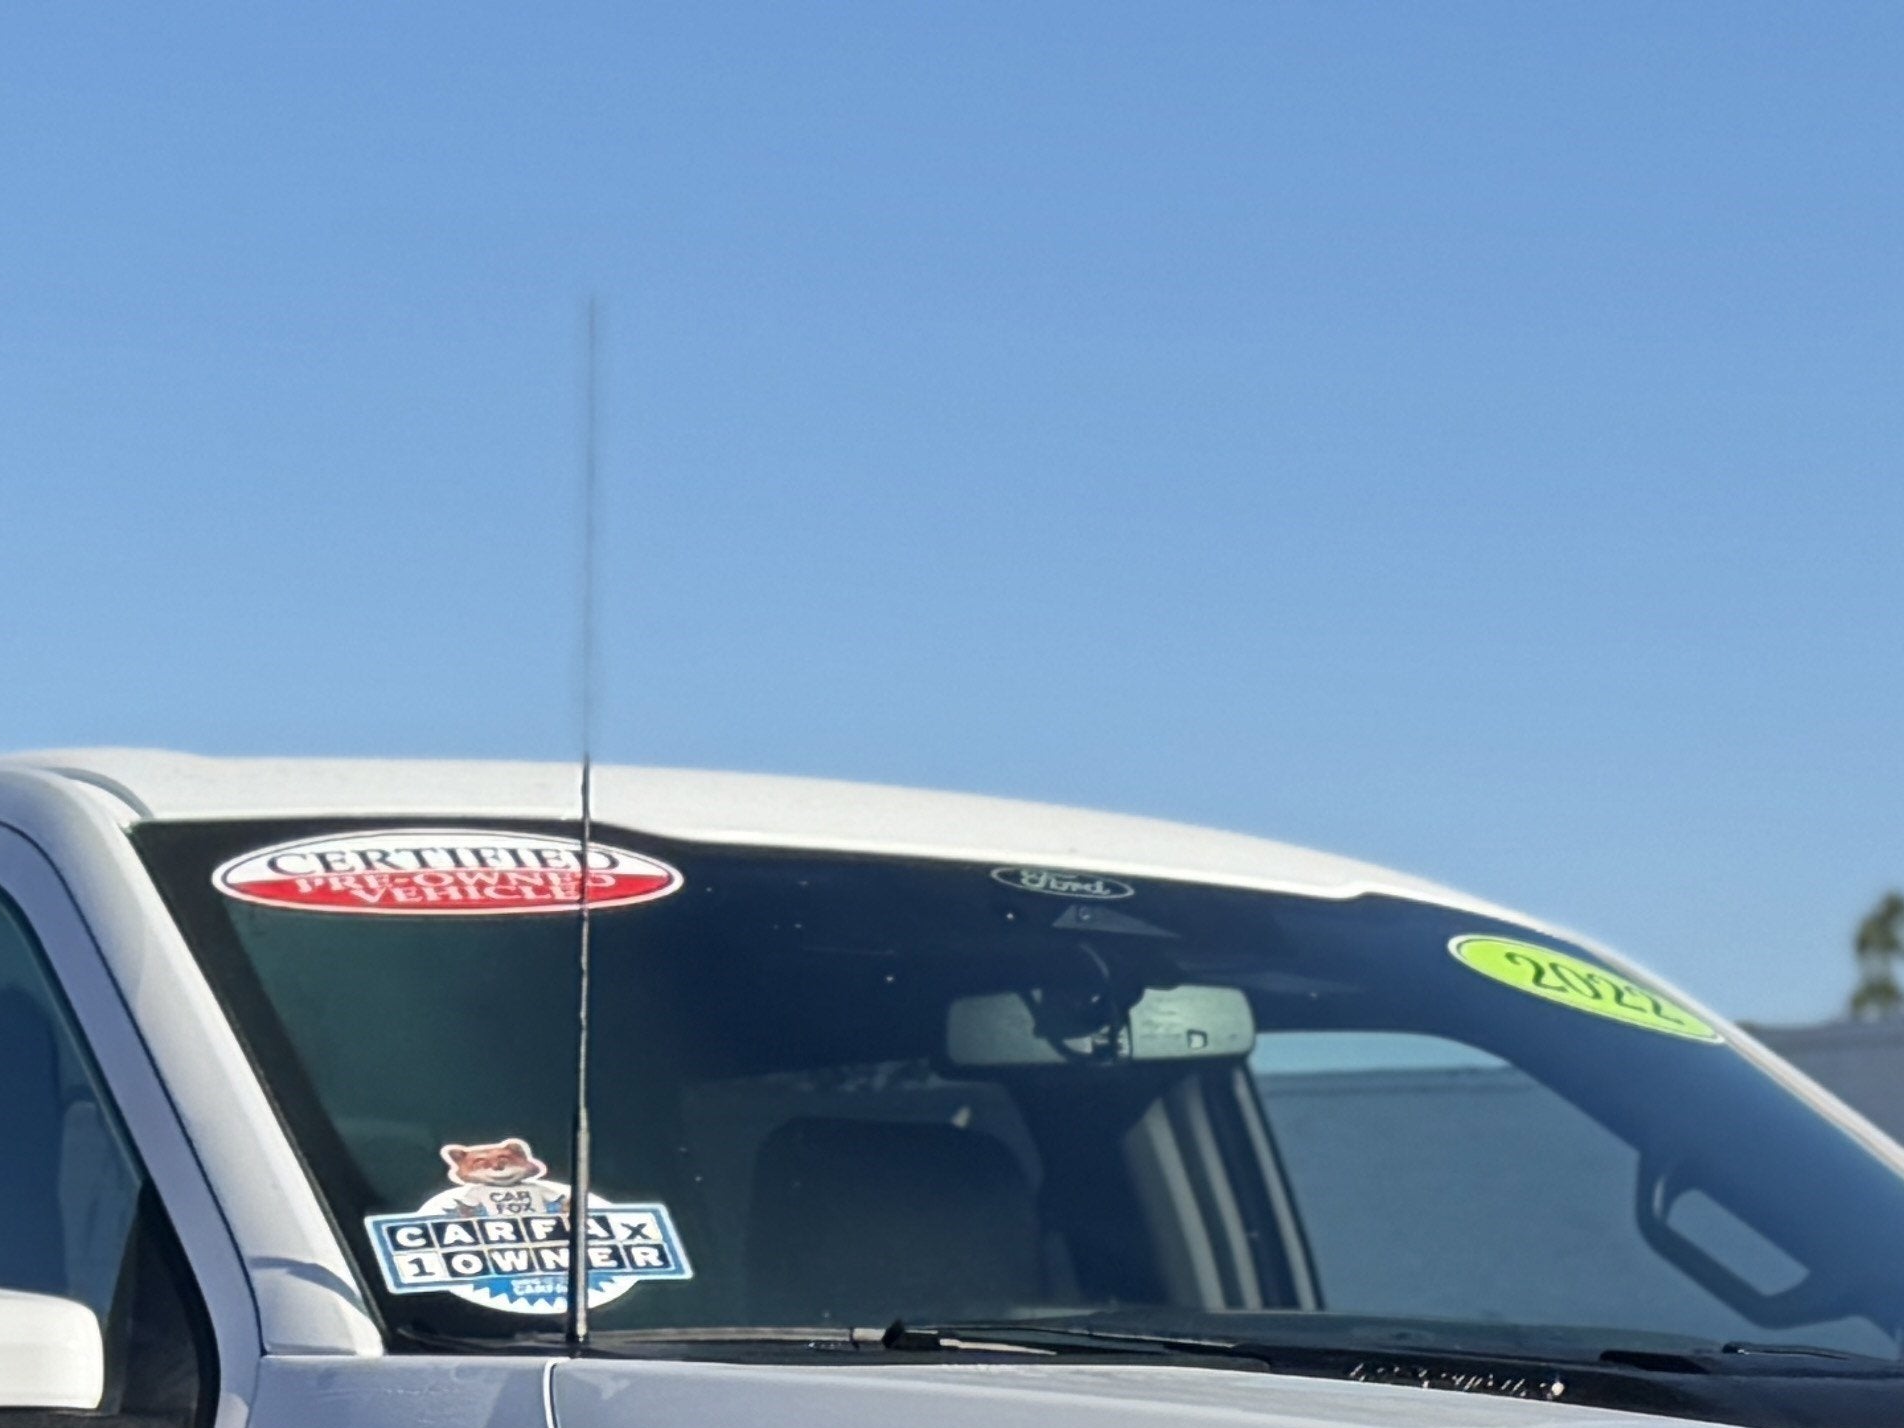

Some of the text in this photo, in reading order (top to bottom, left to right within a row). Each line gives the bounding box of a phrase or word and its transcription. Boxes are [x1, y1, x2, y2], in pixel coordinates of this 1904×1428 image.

[267, 846, 620, 876] CERTIFIED
[295, 871, 617, 894] PRE-OWNED
[352, 884, 582, 906] VEHICLE
[1504, 951, 1685, 1025] 2022
